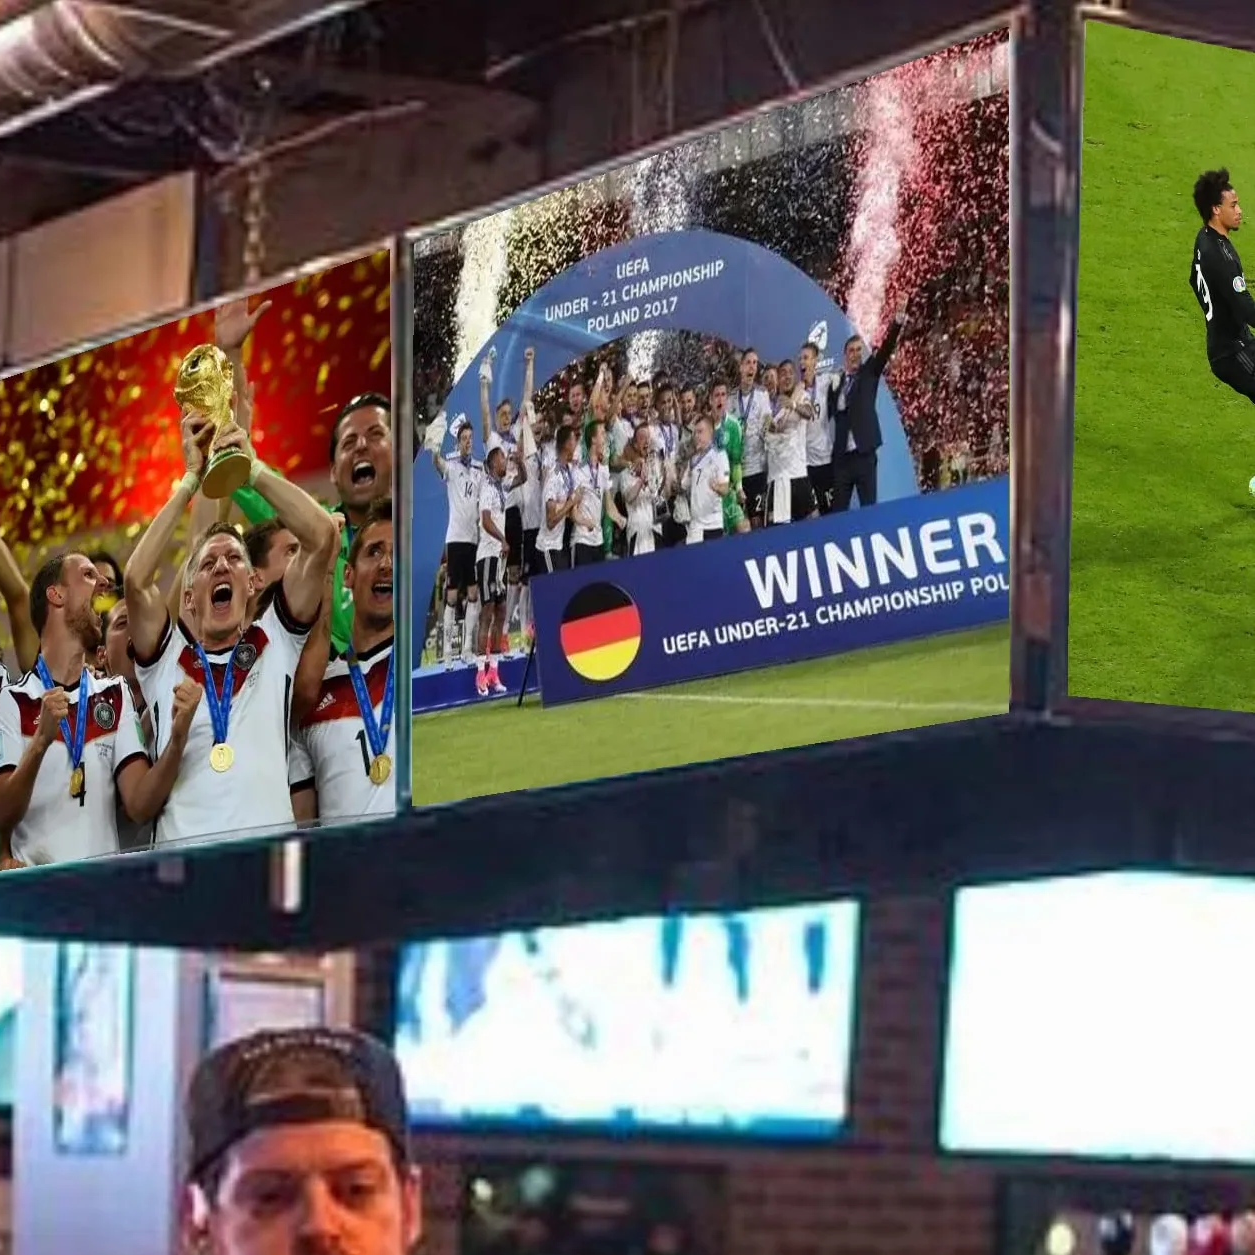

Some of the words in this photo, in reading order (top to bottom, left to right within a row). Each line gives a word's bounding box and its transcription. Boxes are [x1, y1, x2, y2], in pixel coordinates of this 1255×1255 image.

[546, 297, 589, 322] UNDER
[601, 290, 617, 307] 21
[622, 259, 724, 300] CHAMPIONSHIP
[616, 257, 650, 279] UEFA
[587, 307, 640, 333] POLAND
[644, 297, 678, 319] 2017
[746, 512, 1006, 609] WINNER
[663, 629, 711, 655] UEFA
[714, 612, 810, 645] UNDER-21
[815, 581, 965, 625] CHAMPIONSHIP
[971, 573, 1009, 597] POL
